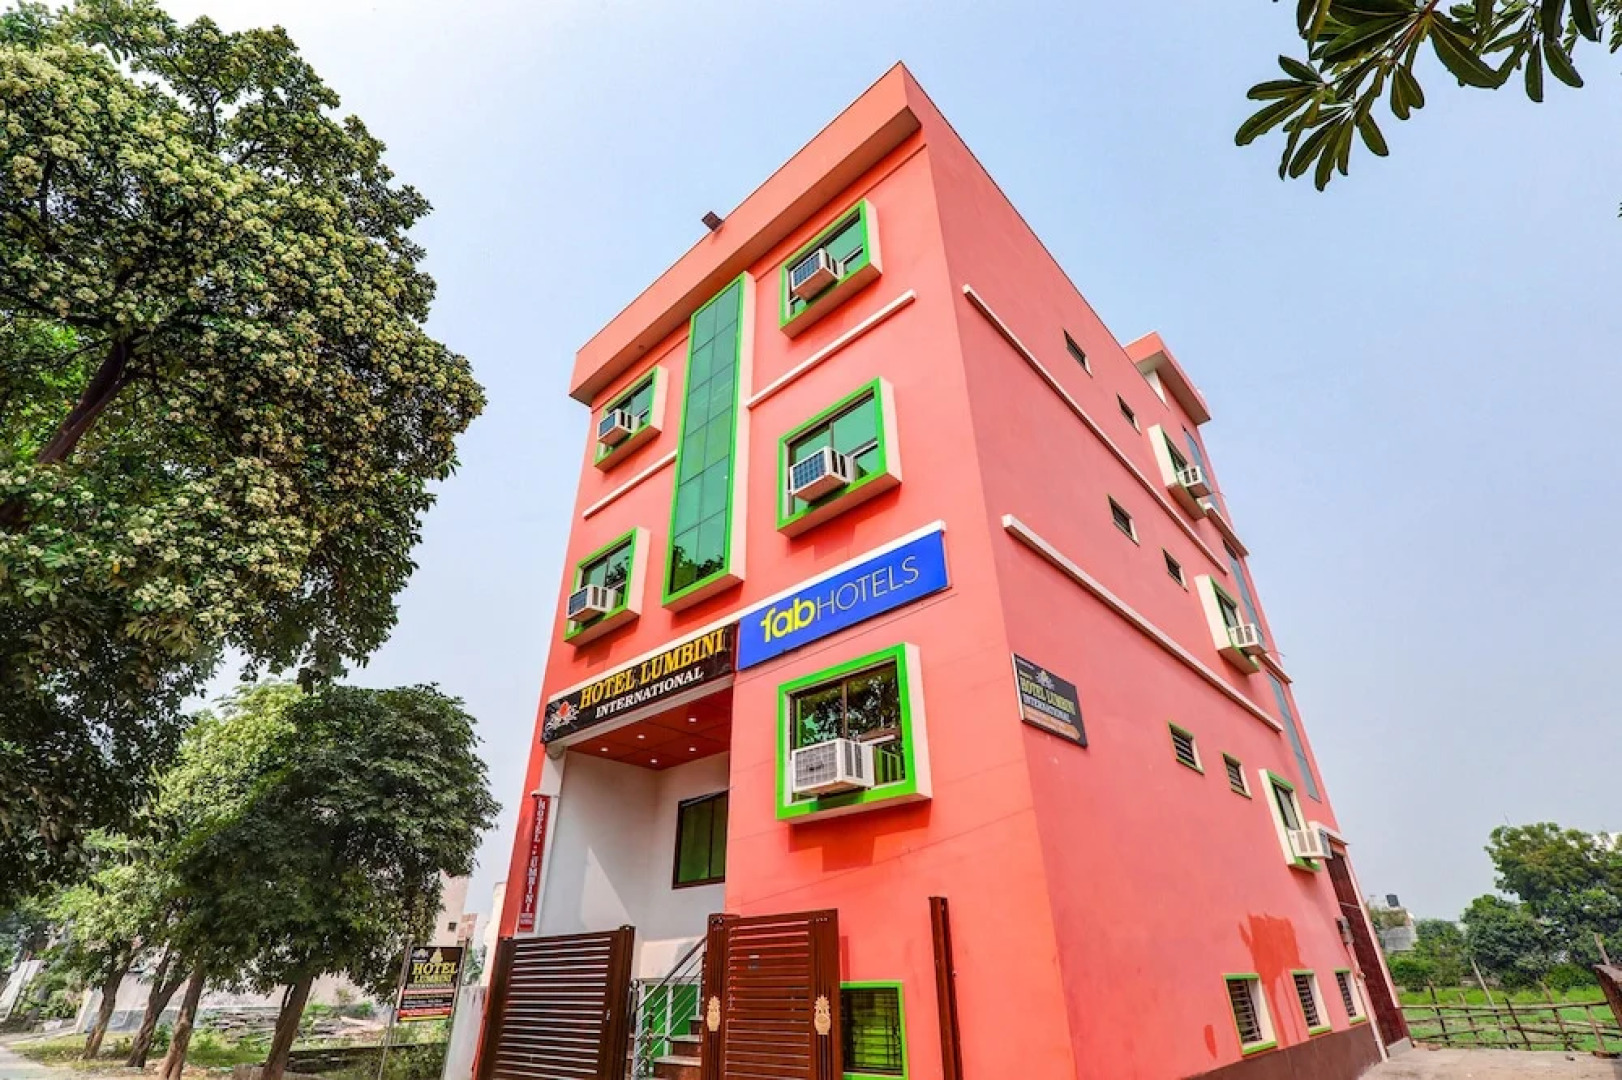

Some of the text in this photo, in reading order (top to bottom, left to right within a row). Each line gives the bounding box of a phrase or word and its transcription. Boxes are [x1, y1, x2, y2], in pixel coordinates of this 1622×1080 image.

[760, 556, 919, 643] fabHOTELS
[579, 628, 725, 710] HOTEL LUMBINI
[595, 667, 704, 719] INTERNATIONAL
[412, 962, 458, 976] HOTEL
